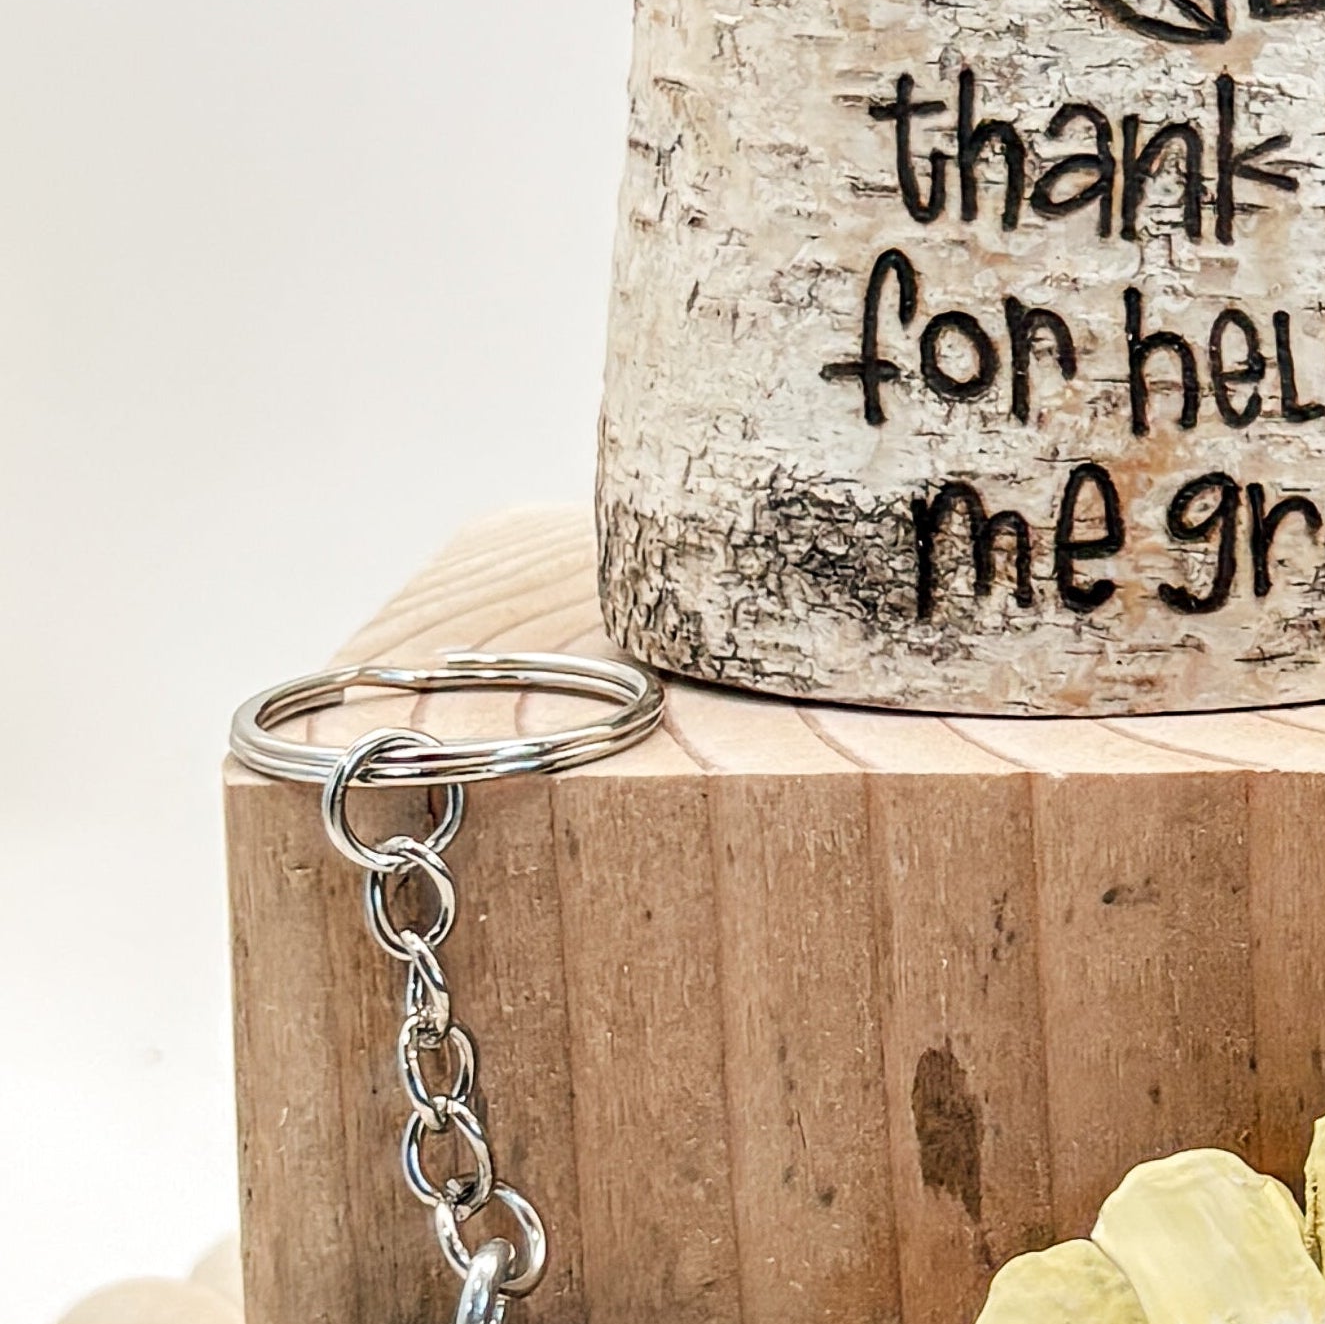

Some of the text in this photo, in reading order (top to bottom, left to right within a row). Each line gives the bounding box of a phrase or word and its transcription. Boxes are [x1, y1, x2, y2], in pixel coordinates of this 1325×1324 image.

[869, 69, 1299, 244] thank
[820, 249, 1077, 425] for
[911, 463, 1126, 620] me
